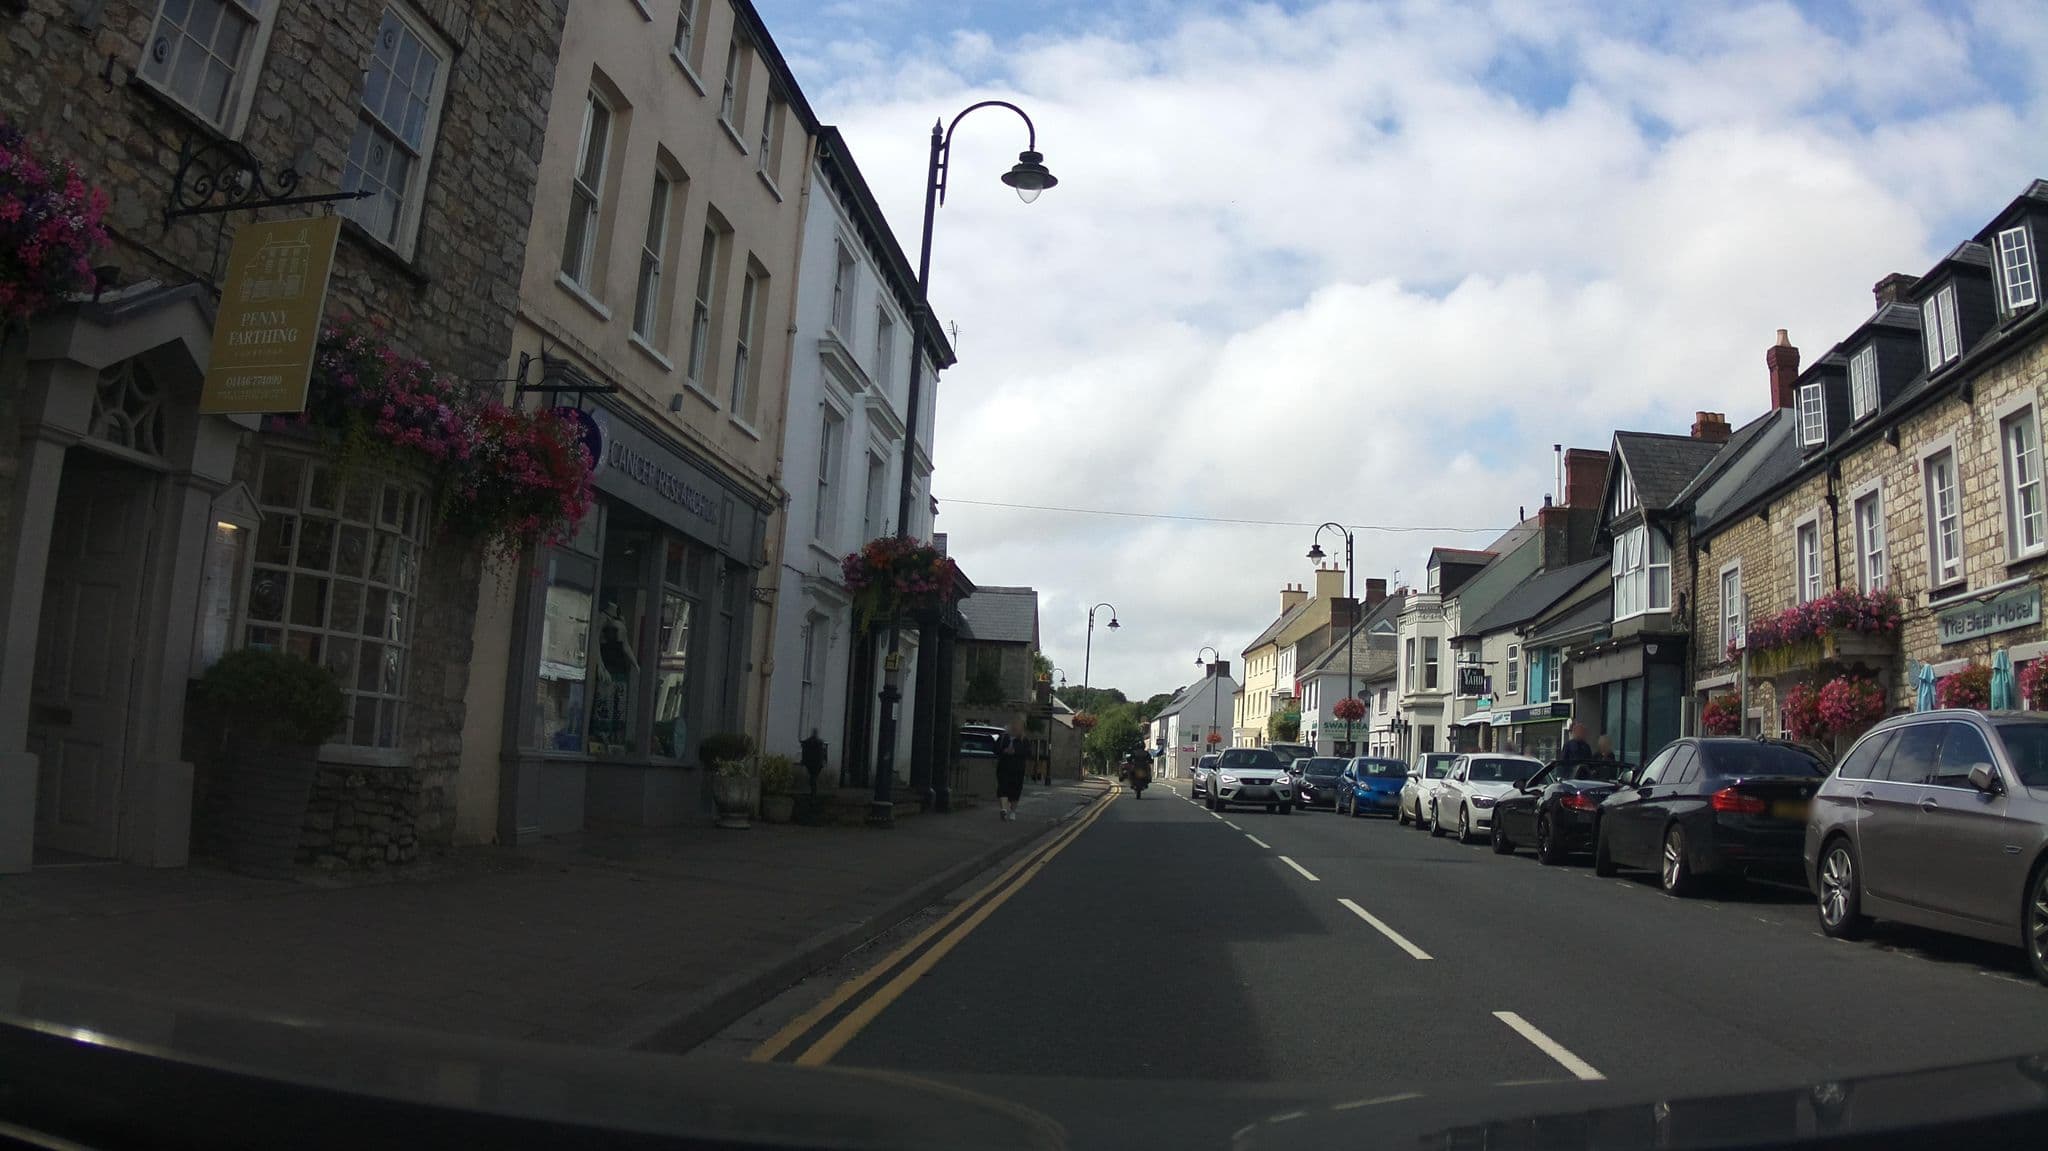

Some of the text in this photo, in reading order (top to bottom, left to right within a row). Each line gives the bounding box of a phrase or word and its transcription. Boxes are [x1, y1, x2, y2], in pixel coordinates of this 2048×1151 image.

[240, 311, 288, 327] PENNY
[229, 328, 298, 345] FARTHING
[609, 439, 657, 485] CANCER
[658, 466, 705, 516] RESEARCH
[1941, 596, 2033, 638] The Bear Hotel
[1462, 668, 1483, 686] YARD
[1323, 721, 1368, 730] SWASEA
